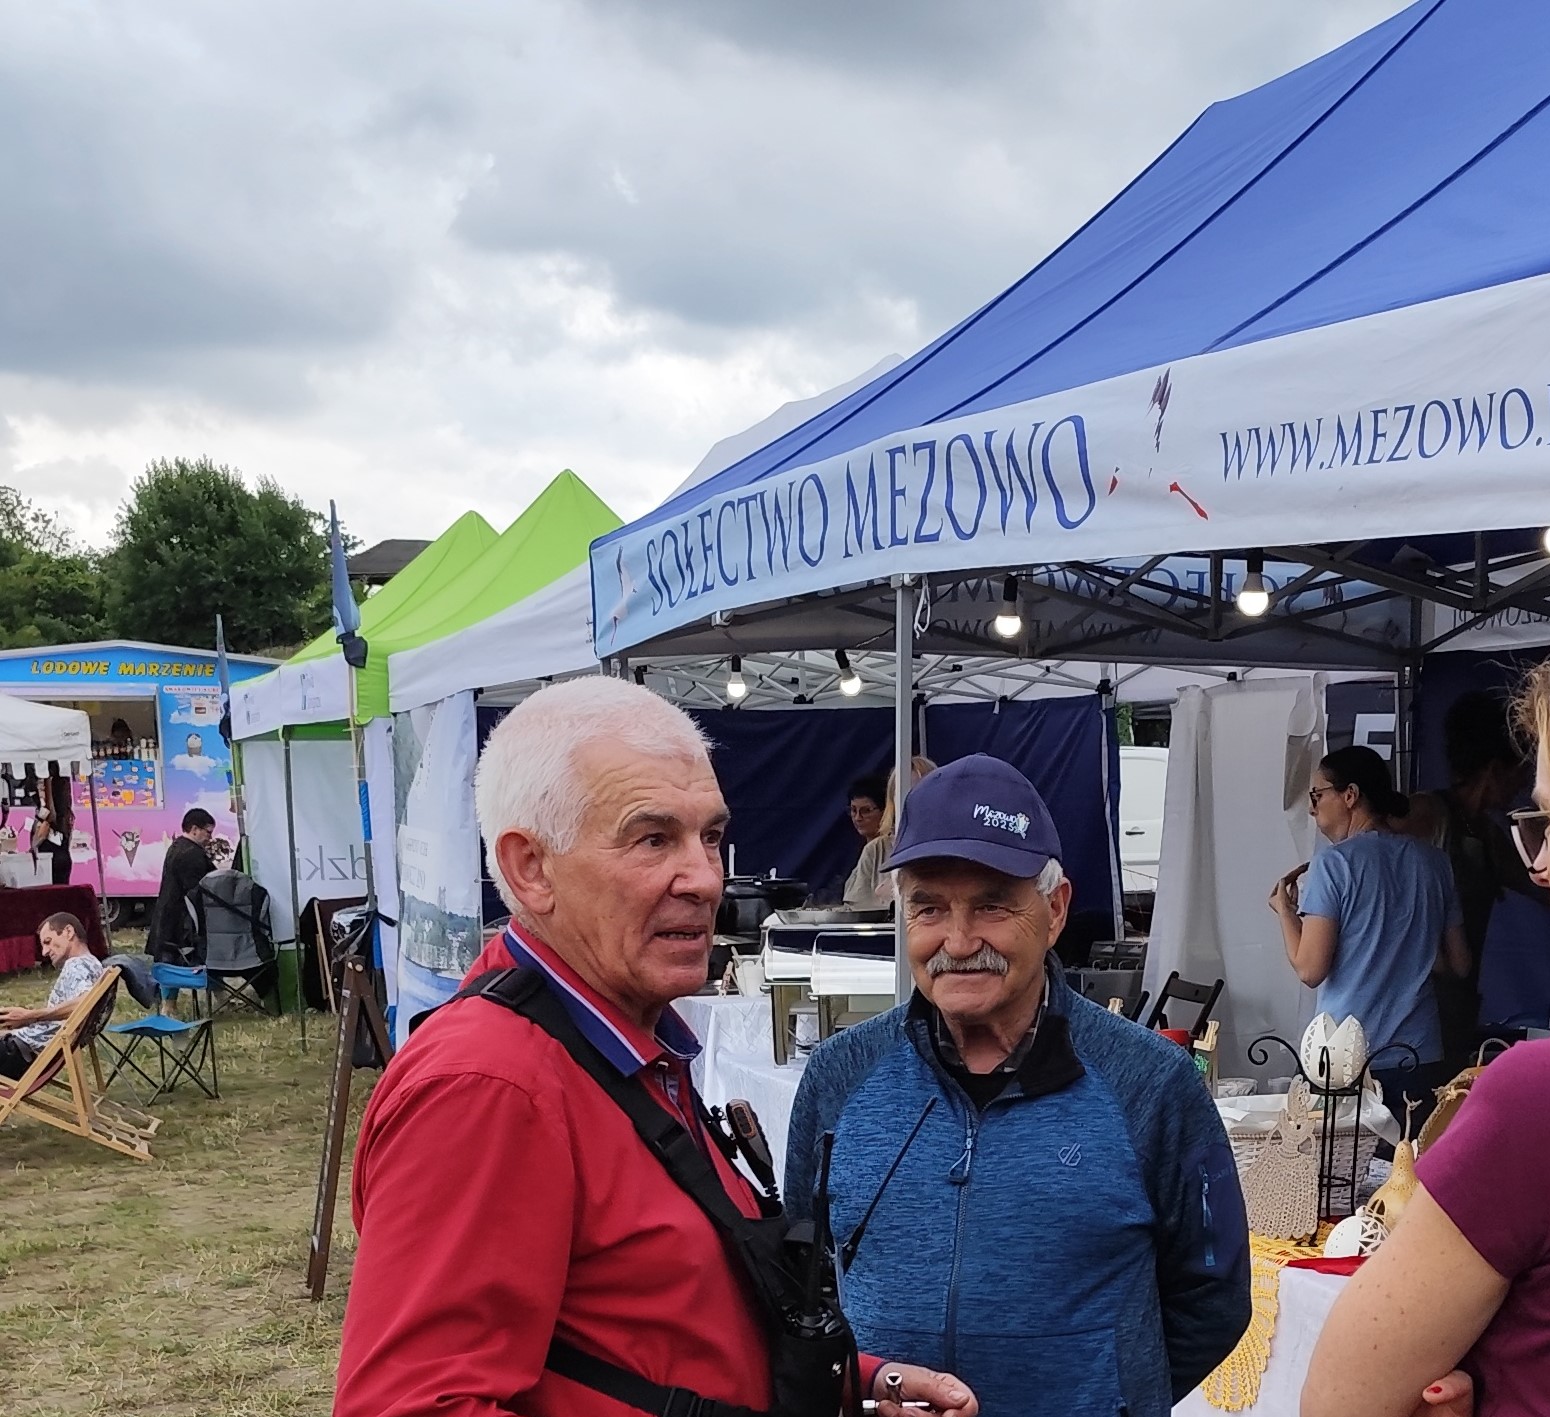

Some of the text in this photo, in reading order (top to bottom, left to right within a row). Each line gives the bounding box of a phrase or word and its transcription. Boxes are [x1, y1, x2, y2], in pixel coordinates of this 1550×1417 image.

[645, 414, 1096, 616] SOŁECTWO MEZOWO
[31, 660, 216, 677] LODOWE MARZENIE
[973, 803, 1017, 825] Mezowo
[983, 817, 1014, 832] 2025
